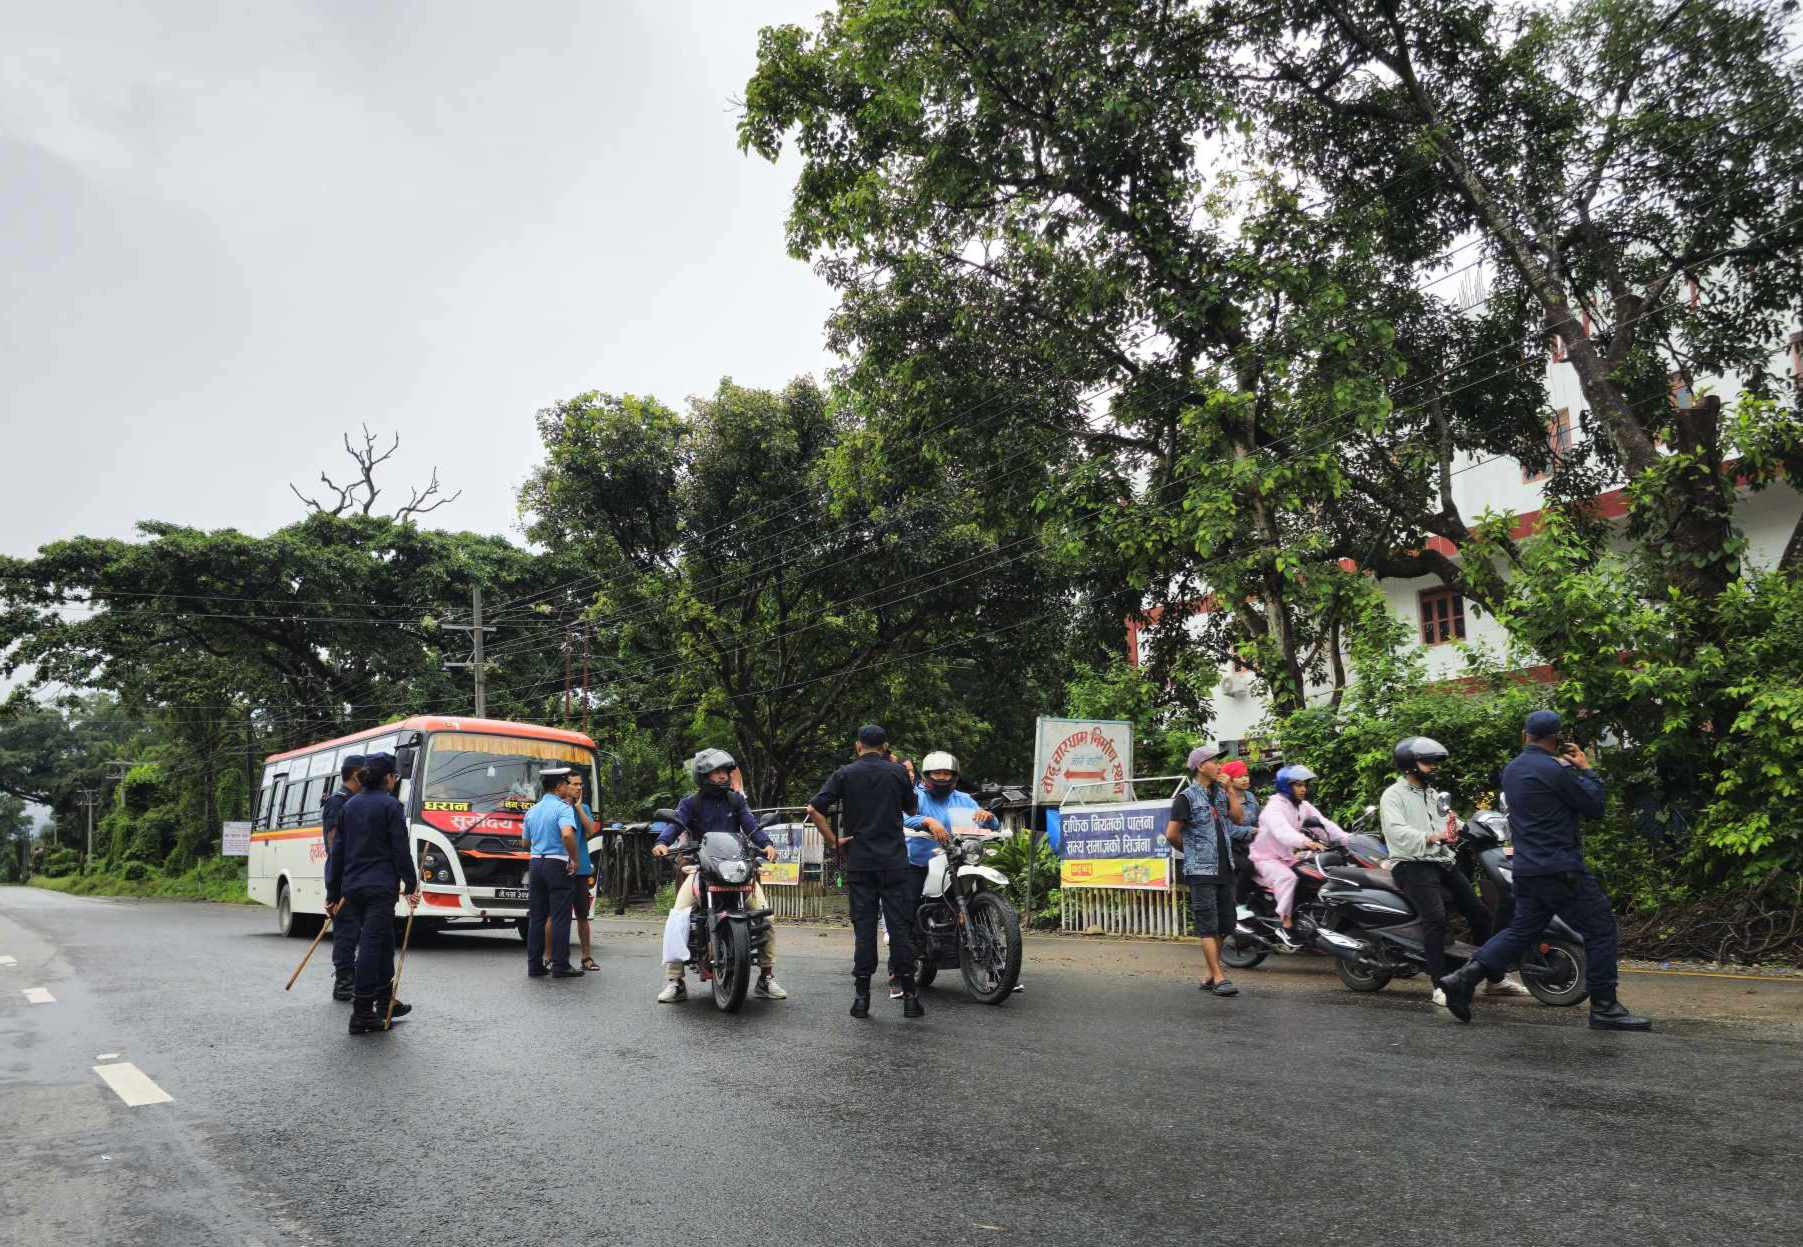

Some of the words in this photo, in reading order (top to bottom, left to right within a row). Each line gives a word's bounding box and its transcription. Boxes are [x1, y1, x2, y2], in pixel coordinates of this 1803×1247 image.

[1063, 816, 1089, 838] ट्राफिक
[1091, 814, 1125, 832] नियमको
[1127, 816, 1154, 831] पालना
[1086, 835, 1120, 854] समाजको
